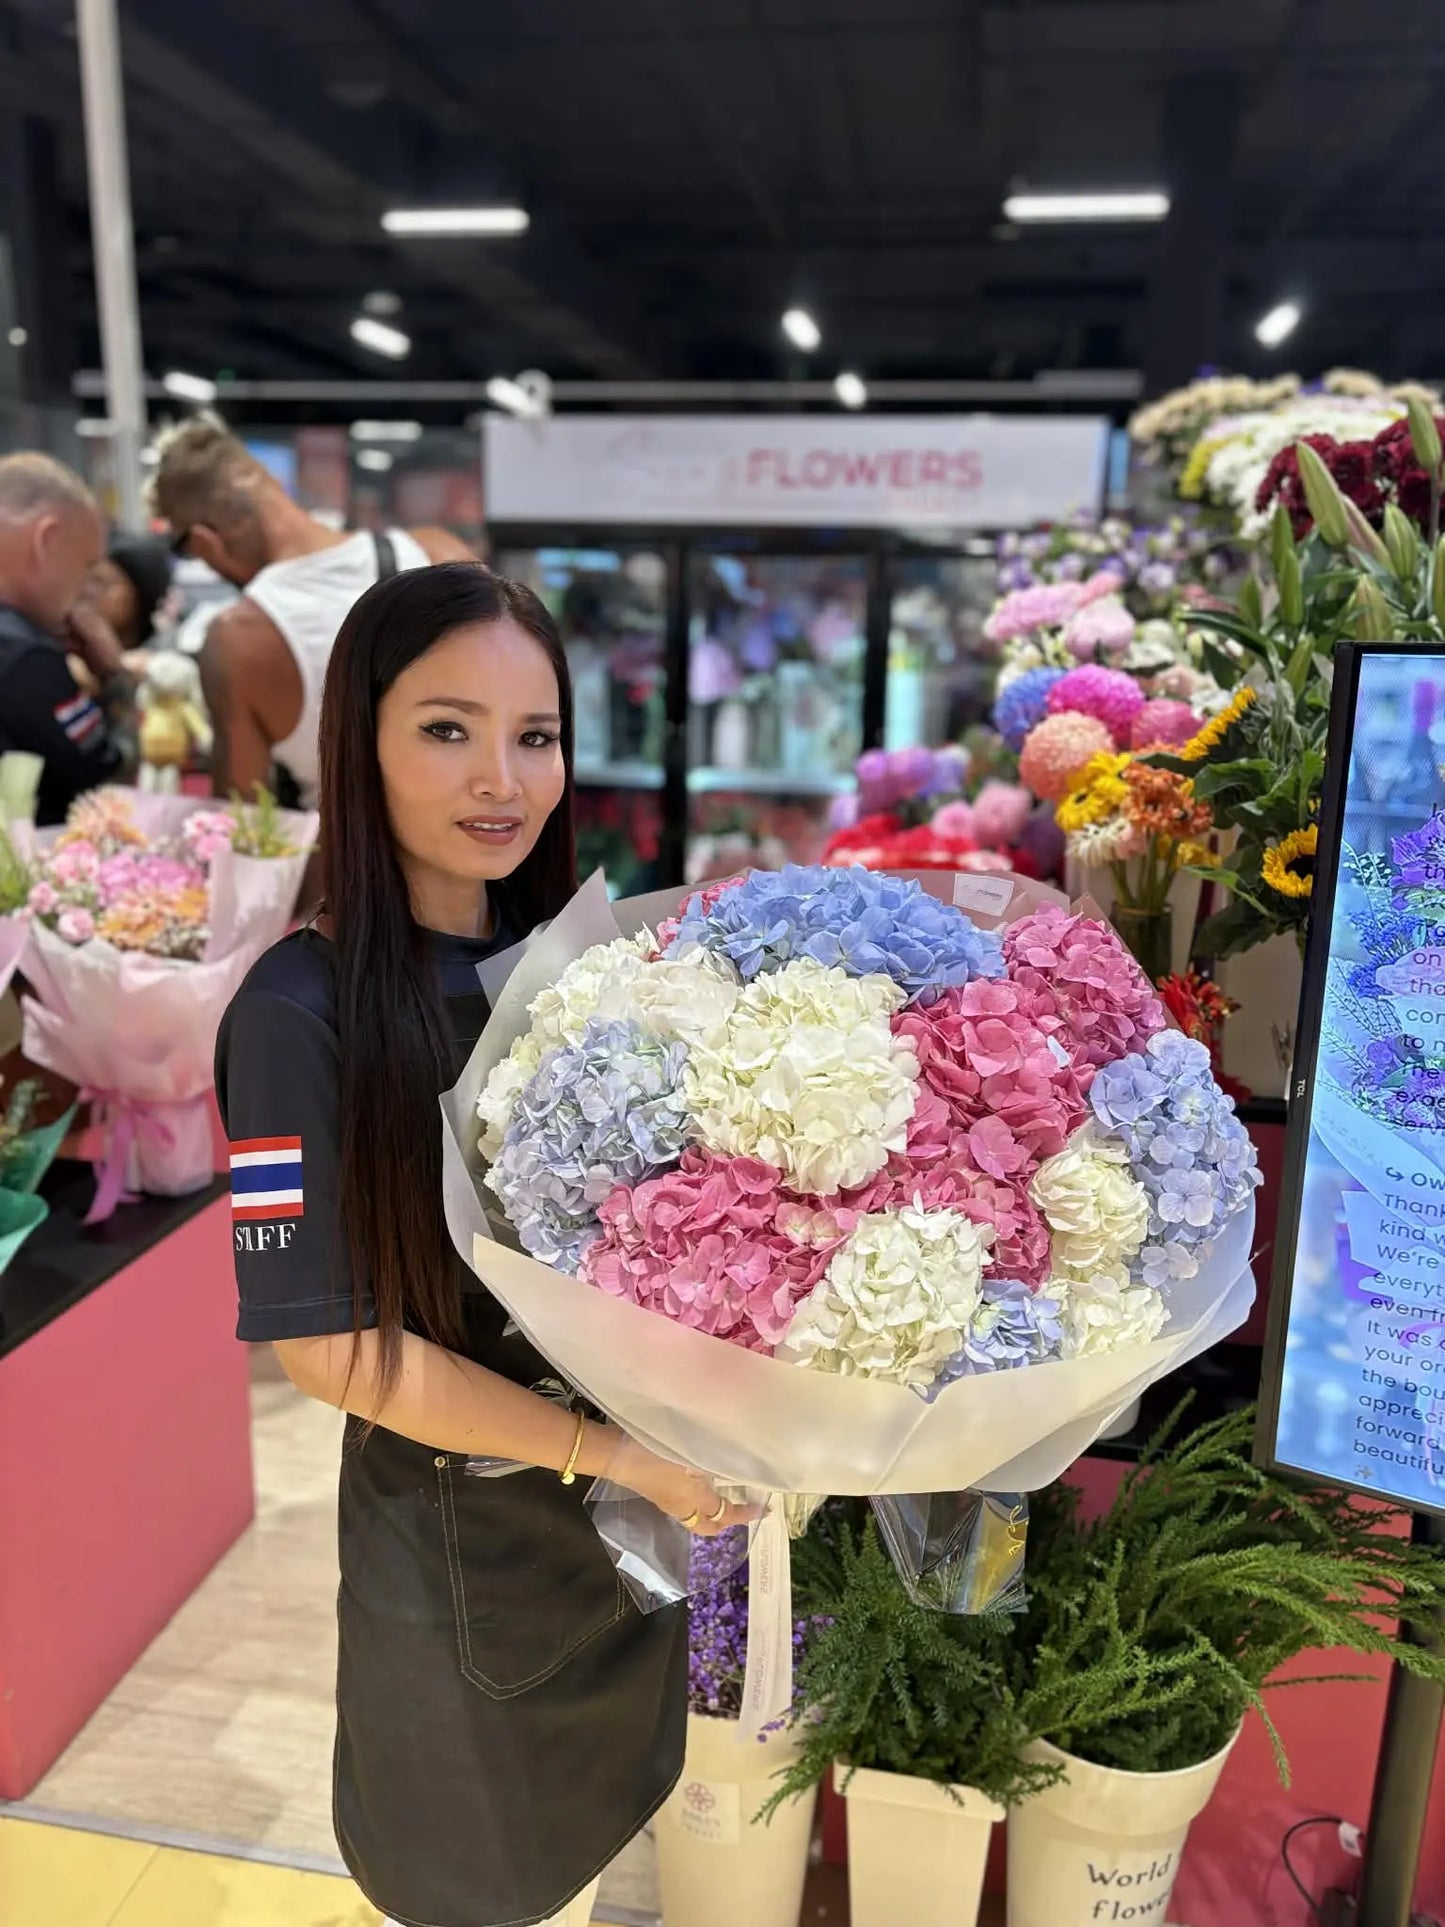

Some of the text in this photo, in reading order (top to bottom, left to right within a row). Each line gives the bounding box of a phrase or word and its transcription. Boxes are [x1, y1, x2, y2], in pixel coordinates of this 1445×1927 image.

[745, 448, 984, 491] FLOWERS
[1413, 952, 1442, 967] on
[1402, 1033, 1425, 1049] to
[1296, 1079, 1306, 1098] TCL
[1379, 1218, 1426, 1242] kind
[1370, 1297, 1423, 1319] even
[1367, 1319, 1381, 1335] It
[1387, 1326, 1432, 1347] was
[1364, 1345, 1413, 1367] your
[1361, 1368, 1397, 1389] the
[1355, 1415, 1441, 1451] forward
[1087, 1852, 1173, 1887] World
